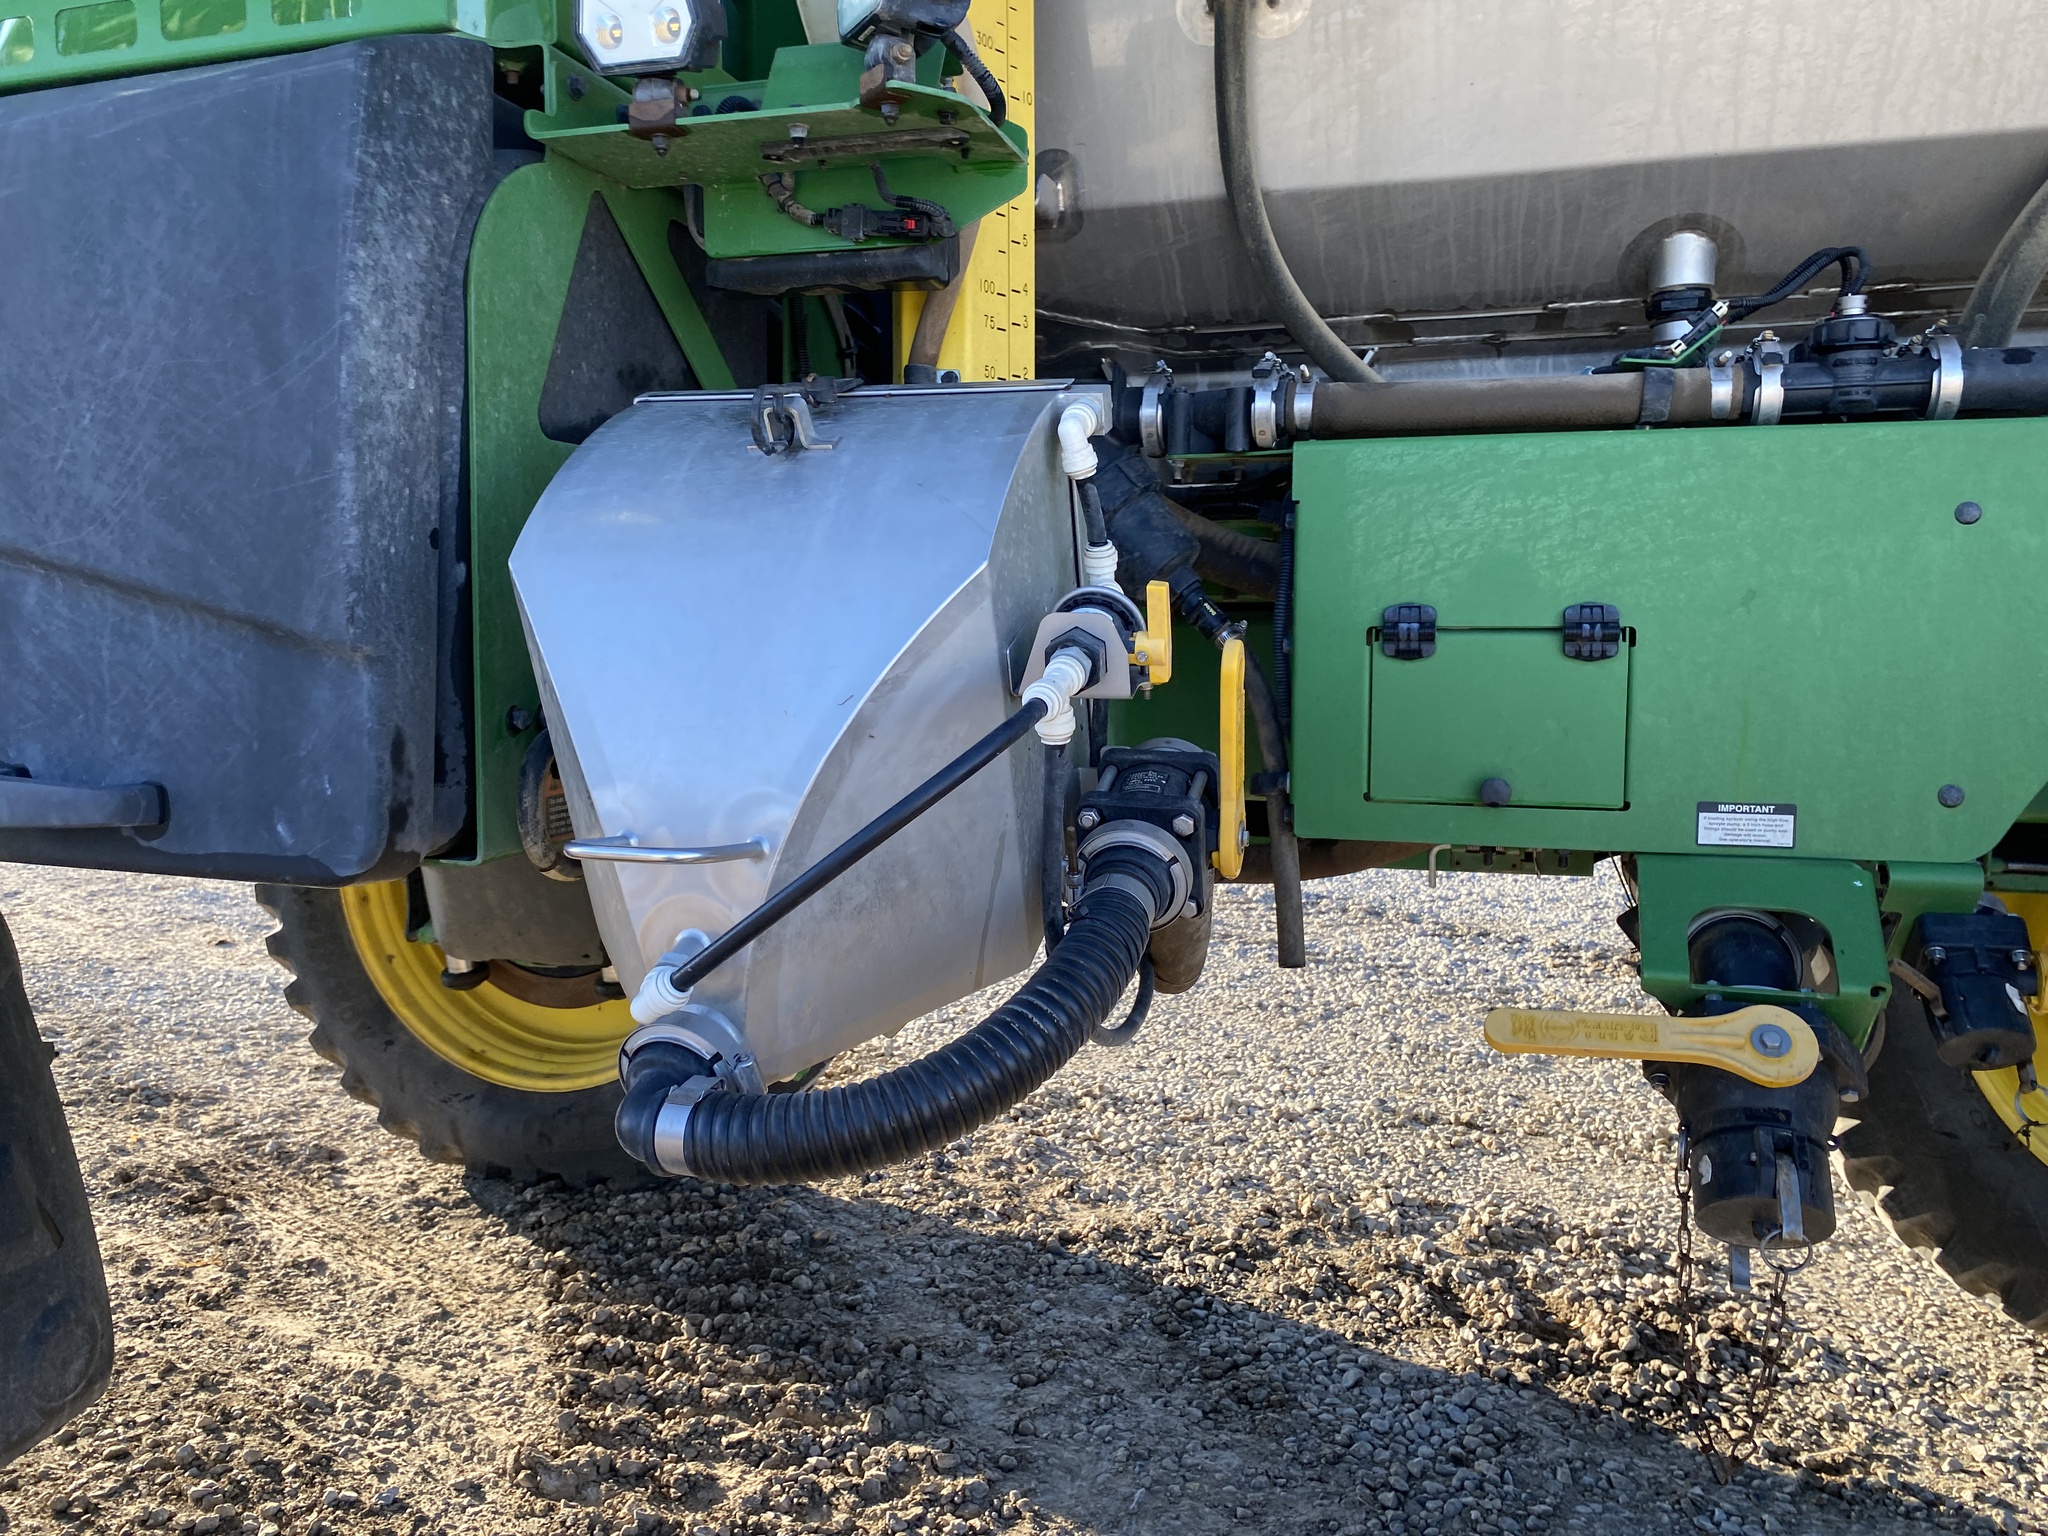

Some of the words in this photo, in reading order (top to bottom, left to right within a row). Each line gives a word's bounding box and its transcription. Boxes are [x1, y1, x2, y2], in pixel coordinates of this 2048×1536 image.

[976, 31, 993, 50] 300
[1022, 91, 1033, 106] 10
[1023, 234, 1028, 248] 5
[980, 278, 996, 295] 100
[1023, 282, 1029, 296] 4
[984, 314, 996, 330] 75
[1023, 315, 1029, 329] 3
[984, 365, 996, 380] 50
[1023, 367, 1029, 380] 2
[1718, 804, 1775, 814] IMPORTANT
